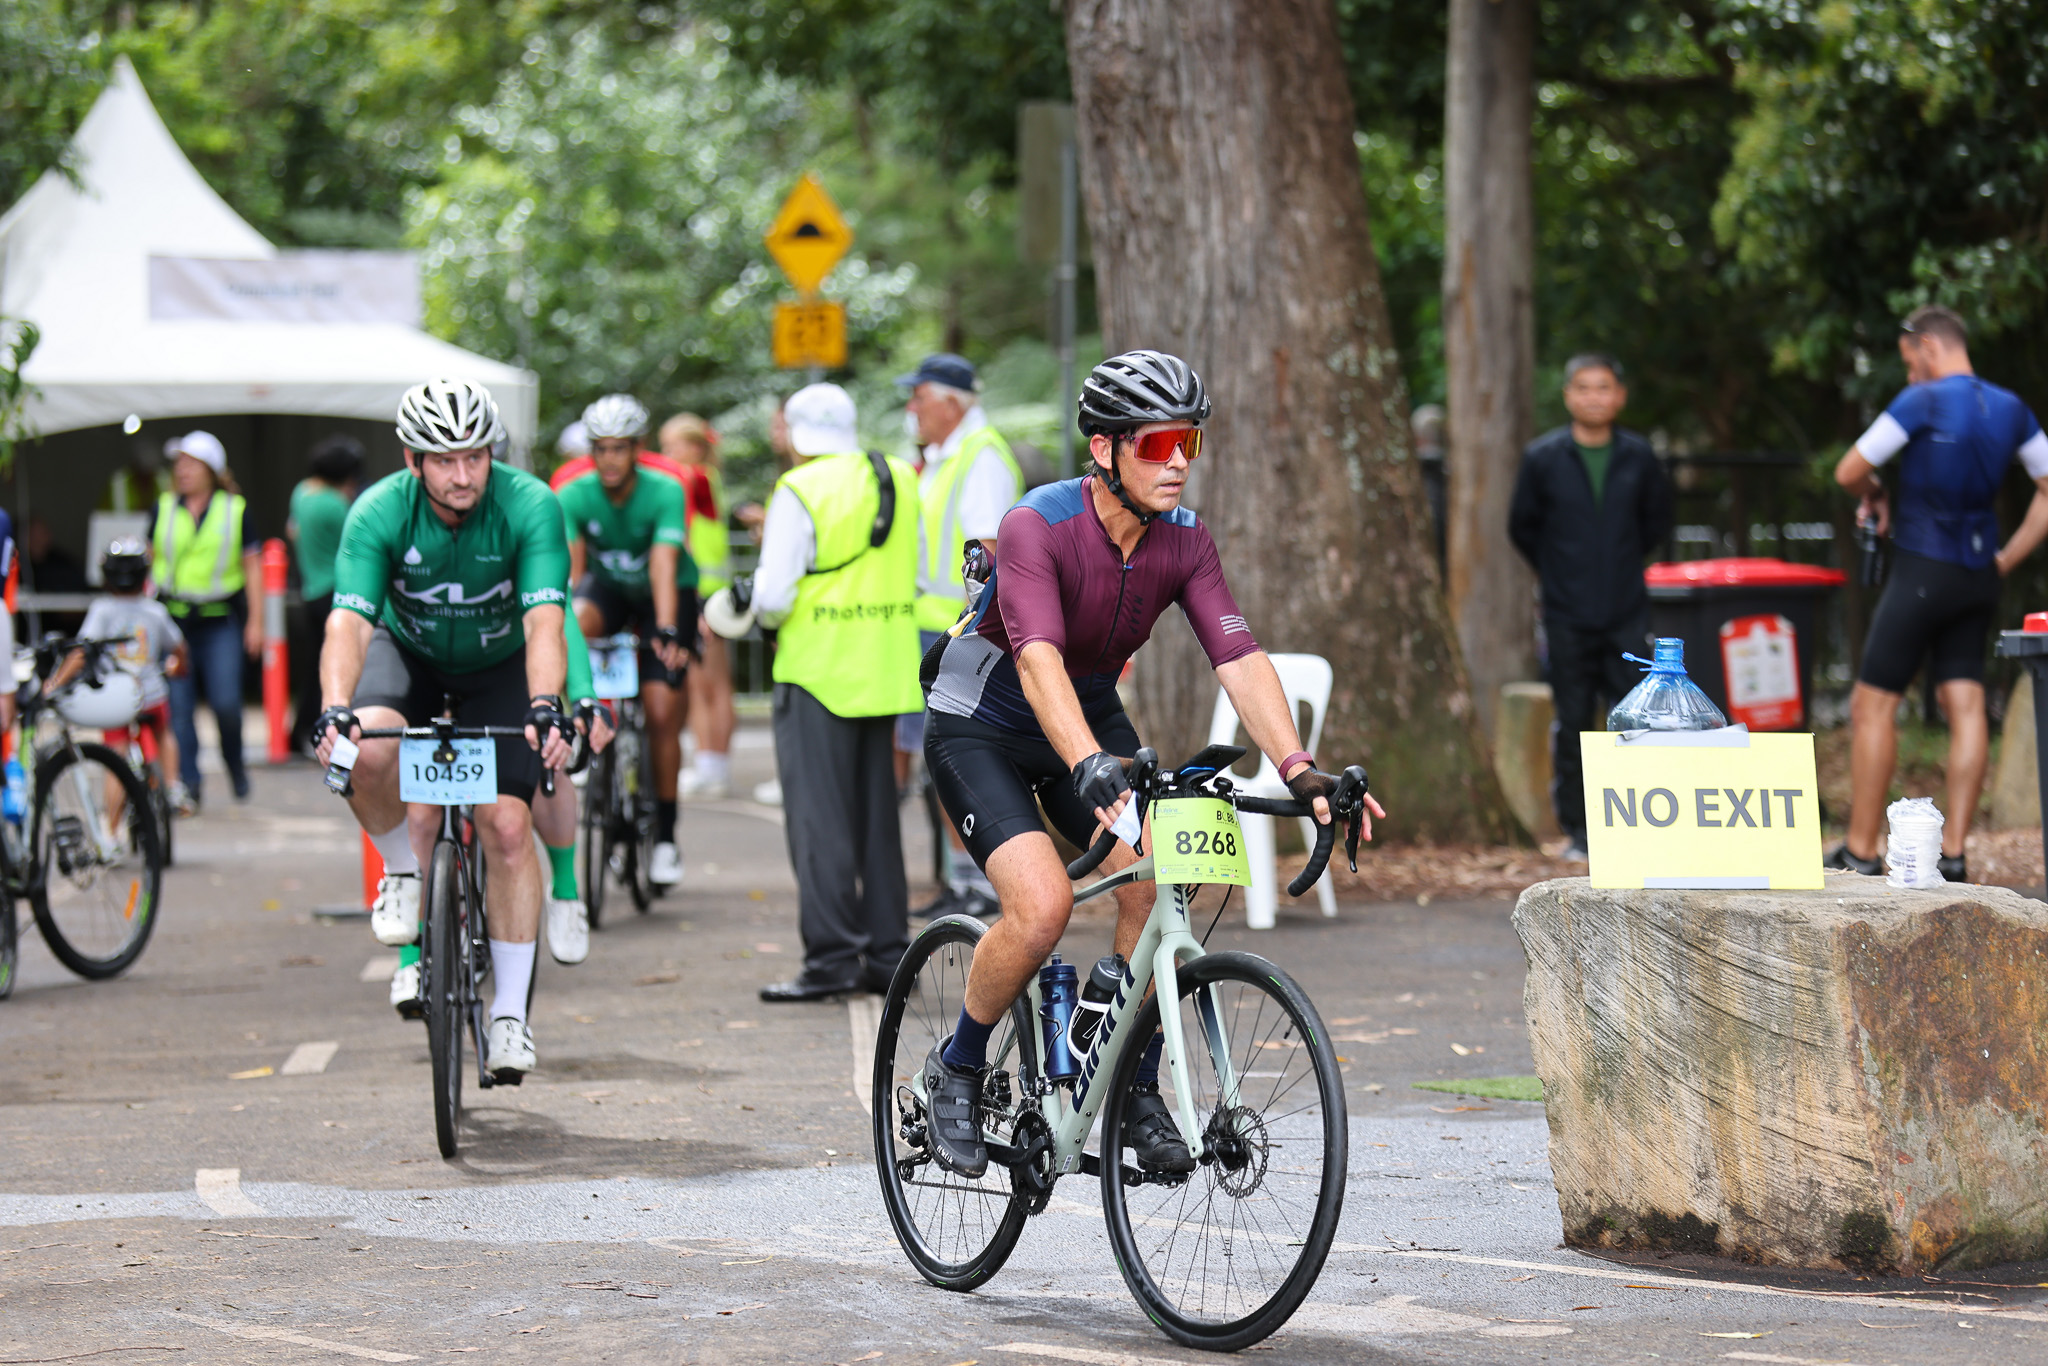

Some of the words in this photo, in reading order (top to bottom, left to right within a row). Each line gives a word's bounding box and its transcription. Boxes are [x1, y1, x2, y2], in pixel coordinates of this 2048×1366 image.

[412, 763, 484, 783] 10459
[1602, 787, 1679, 828] NO
[1694, 788, 1803, 829] EXIT
[1175, 830, 1237, 857] 8268
